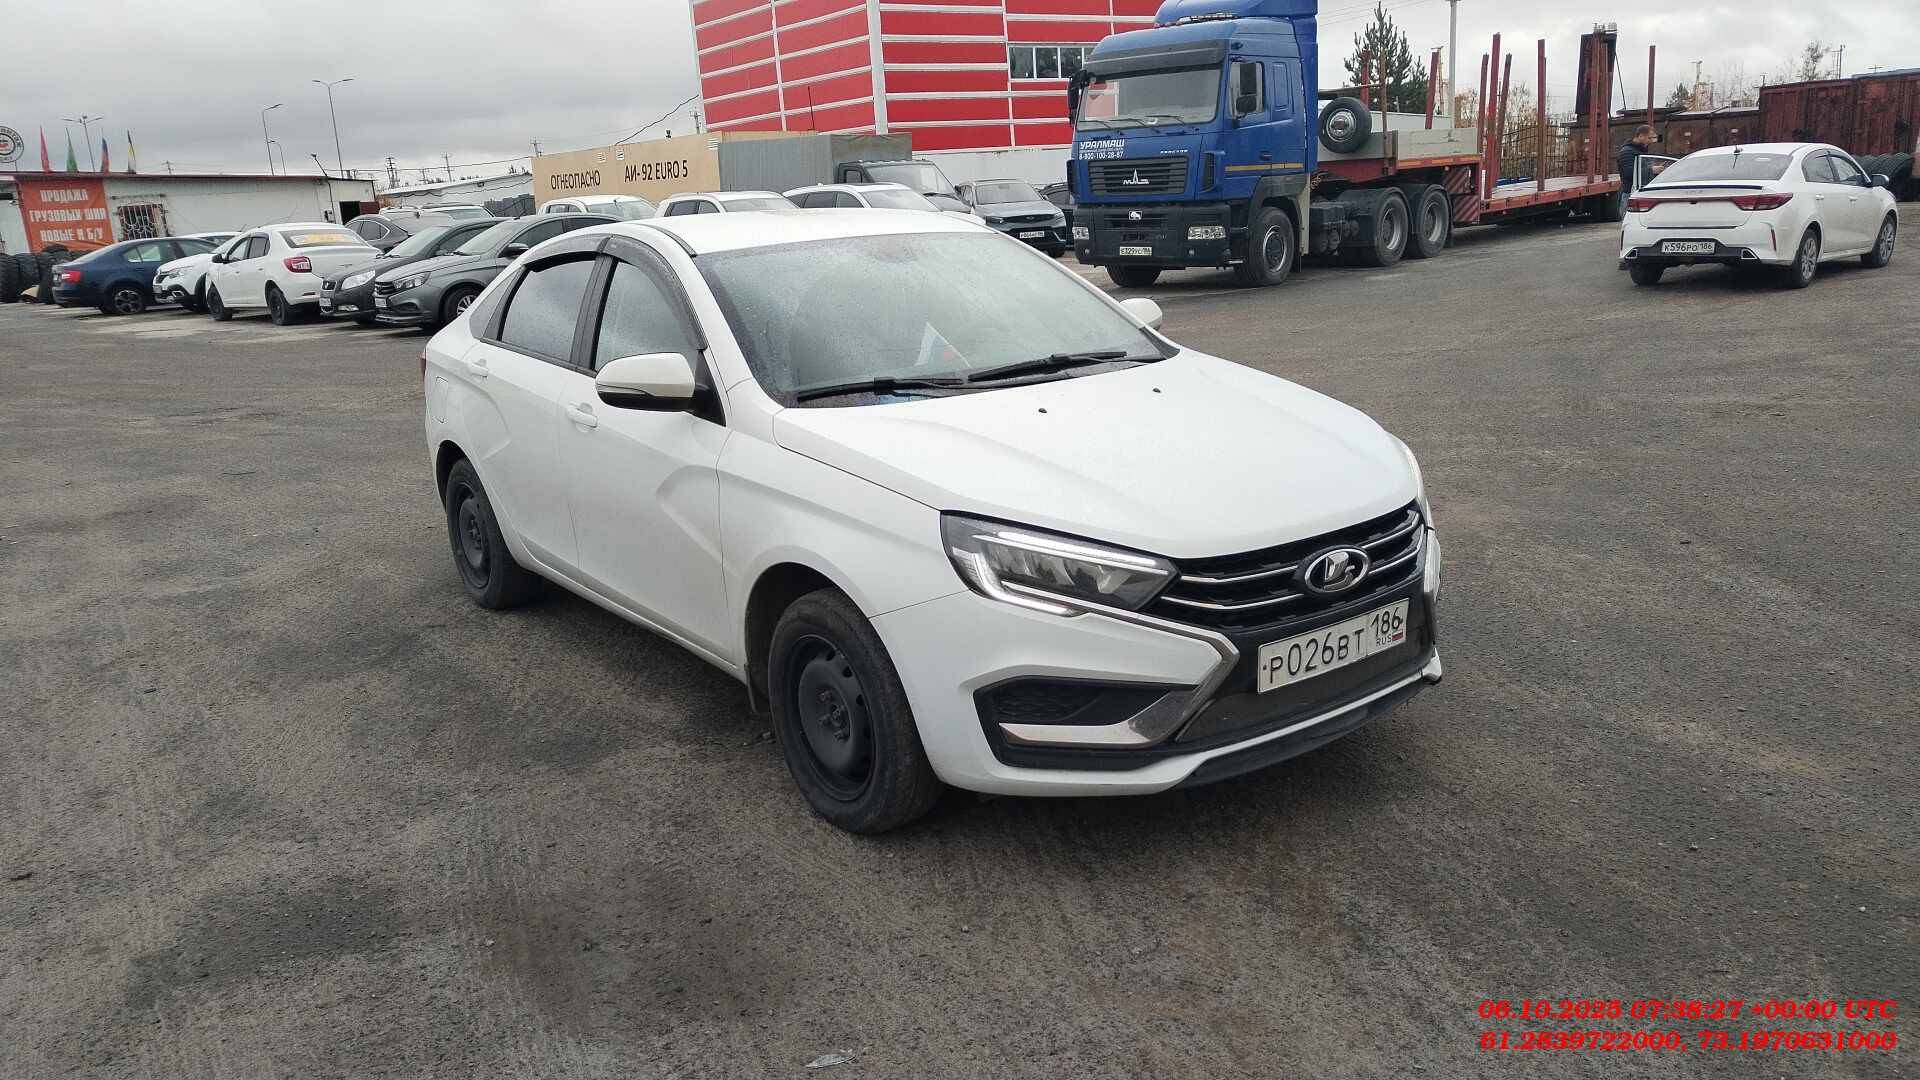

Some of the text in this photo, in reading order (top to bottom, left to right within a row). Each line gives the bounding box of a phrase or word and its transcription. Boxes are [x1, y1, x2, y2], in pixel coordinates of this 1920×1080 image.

[1080, 139, 1125, 150] УРАЛМАШ
[655, 160, 680, 180] EURO
[682, 159, 688, 178] 5
[550, 169, 601, 190] ОГНЕОПАСНО
[40, 189, 88, 203] ПРОДАЖА
[29, 209, 82, 222] ГРУЗОВЫХ
[40, 226, 103, 242] НОВЫЕ И Б/У
[1269, 606, 1401, 684] Р026ВТ 186
[1376, 633, 1392, 647] RUS
